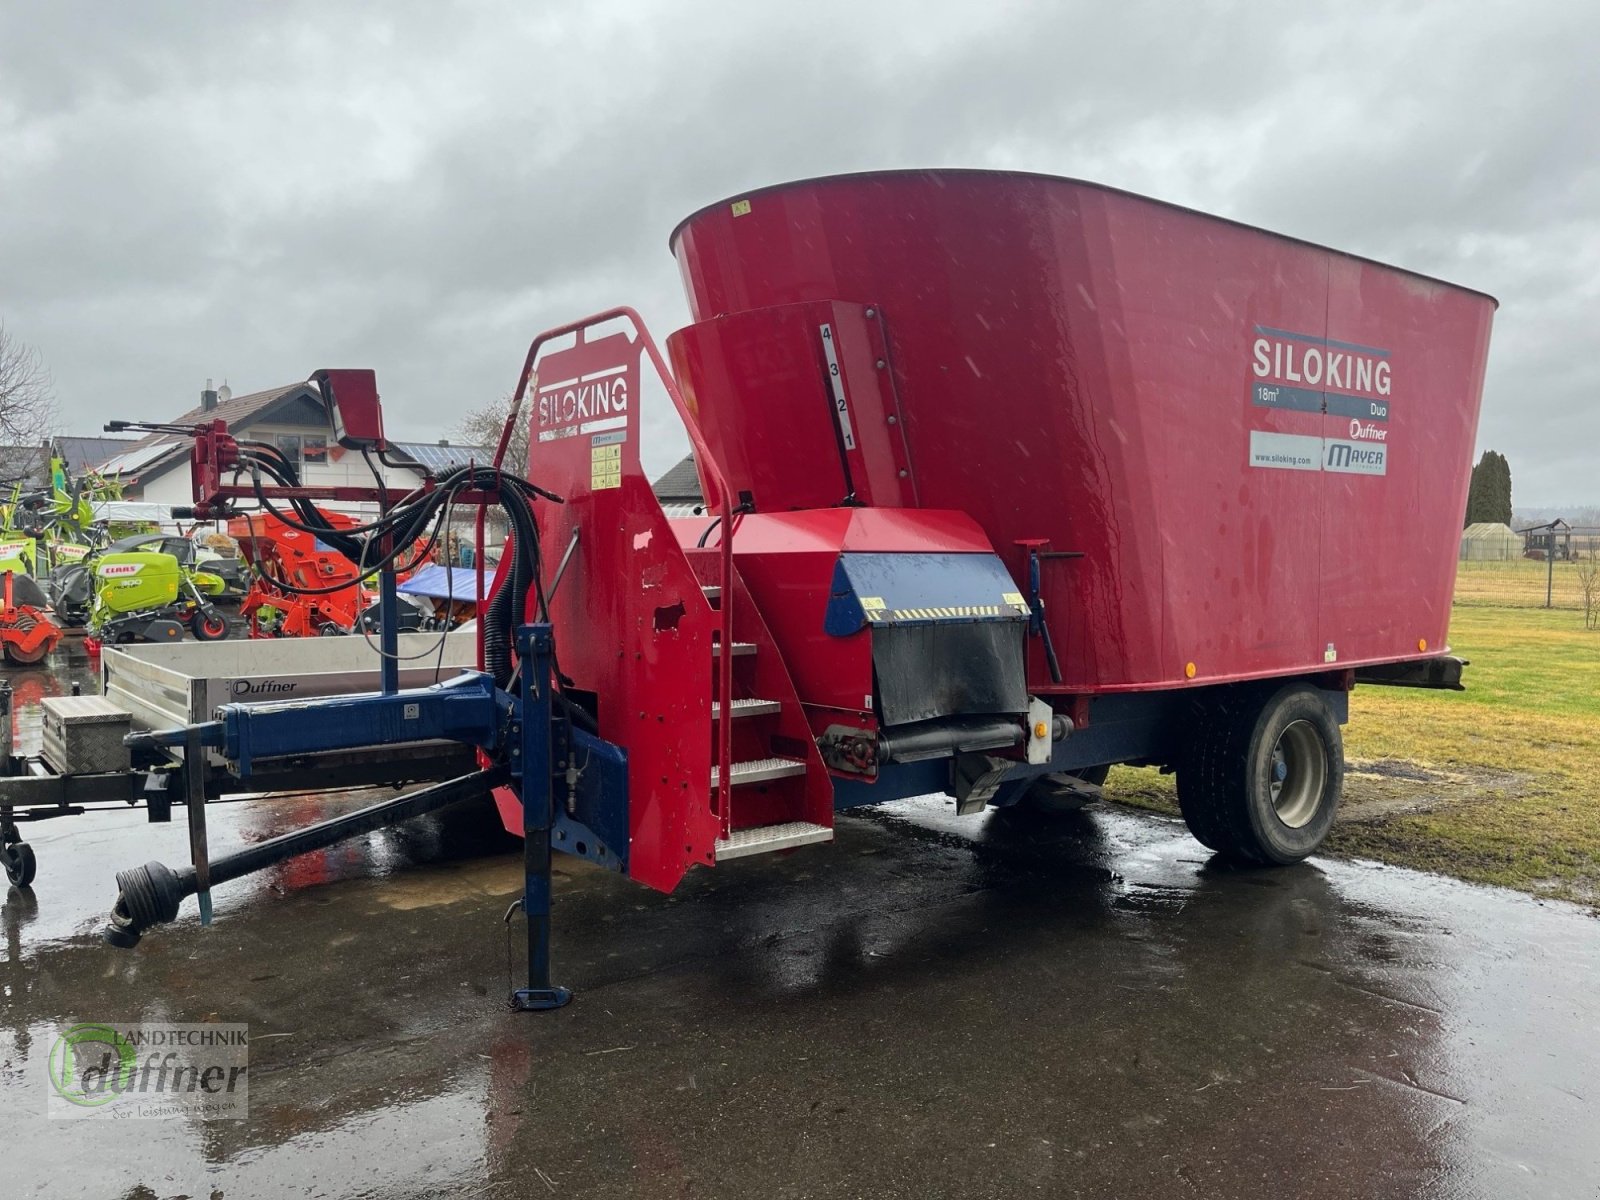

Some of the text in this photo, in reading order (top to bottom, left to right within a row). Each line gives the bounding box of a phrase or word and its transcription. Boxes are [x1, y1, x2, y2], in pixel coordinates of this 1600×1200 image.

[823, 327, 831, 340] 4
[830, 363, 839, 376] 3
[1252, 339, 1391, 395] SILOKING
[539, 377, 627, 427] SILOKING
[837, 398, 847, 412] 2
[1370, 402, 1387, 417] Duo
[1350, 418, 1387, 440] Duffner
[845, 433, 852, 446] 1
[1254, 453, 1312, 465] www.siloking.com
[105, 565, 136, 574] CLAAS
[232, 679, 297, 695] Duffner
